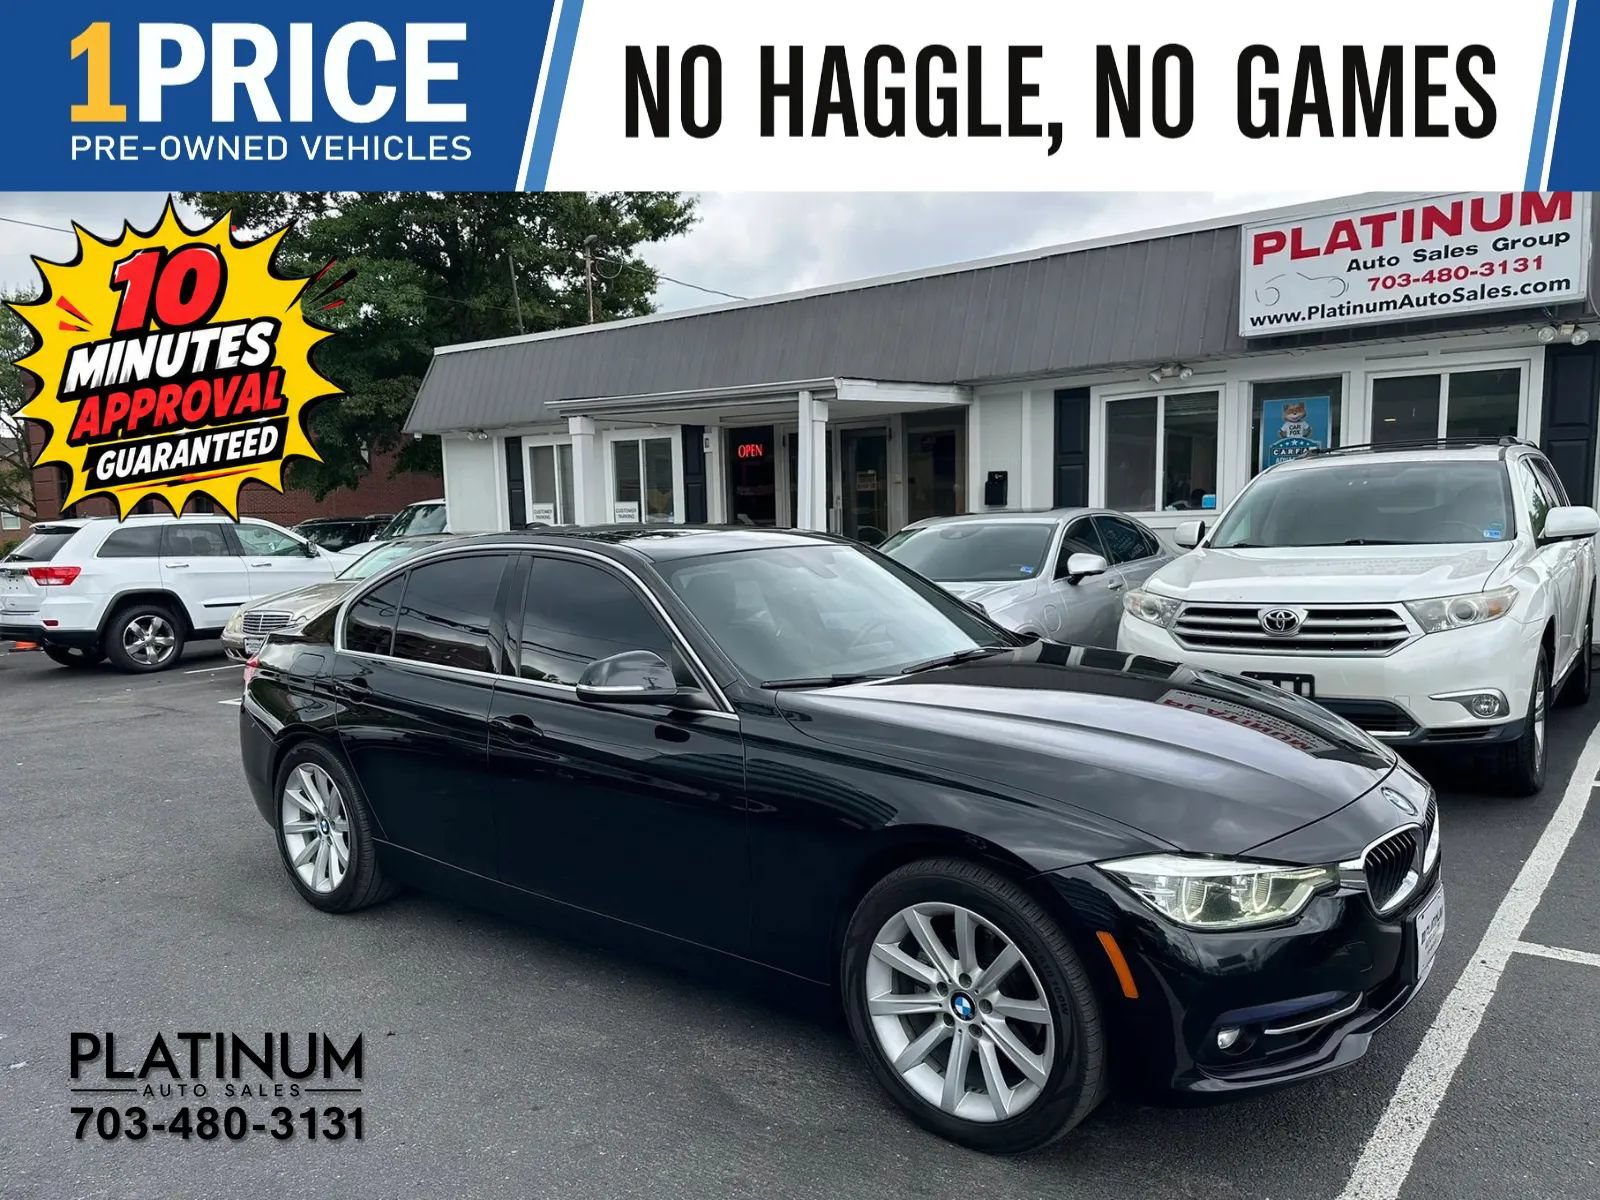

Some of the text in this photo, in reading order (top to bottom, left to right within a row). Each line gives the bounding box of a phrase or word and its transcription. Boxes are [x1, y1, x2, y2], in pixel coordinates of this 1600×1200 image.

[1253, 192, 1573, 266] PLATINUM
[1347, 231, 1571, 272] Auto Sales Group
[1367, 255, 1543, 292] 703-480-3131
[1250, 278, 1571, 327] www.PlatinumAutoSales.com
[738, 444, 763, 458] OPEN
